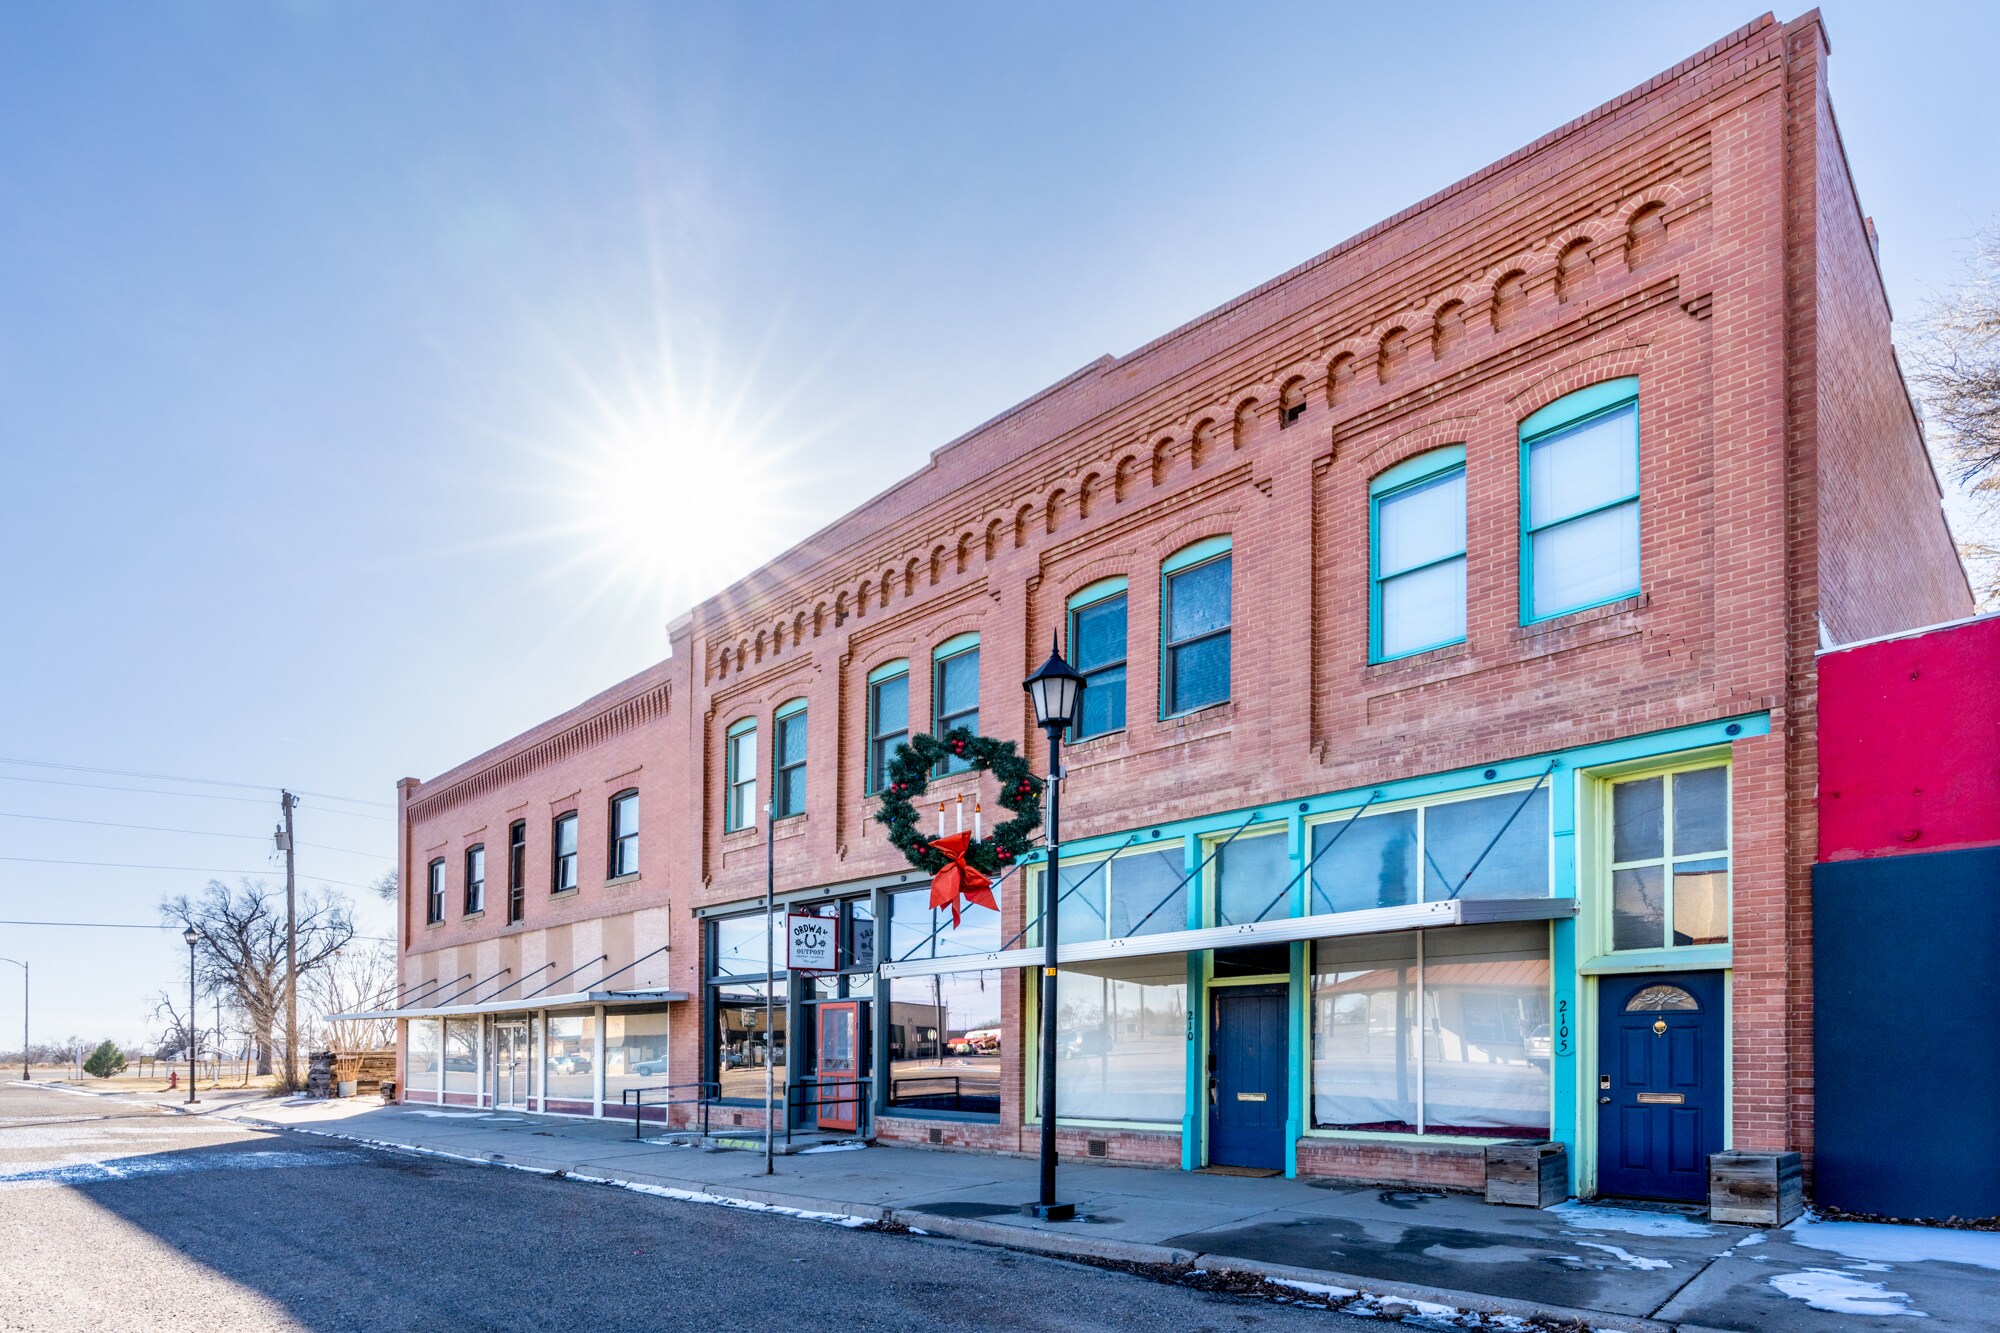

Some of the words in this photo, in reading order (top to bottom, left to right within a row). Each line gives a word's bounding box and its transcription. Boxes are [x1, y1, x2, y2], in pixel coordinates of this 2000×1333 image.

[793, 923, 828, 936] ORDWAY
[796, 948, 826, 956] OUTPOST
[1559, 1000, 1569, 1053] 2105
